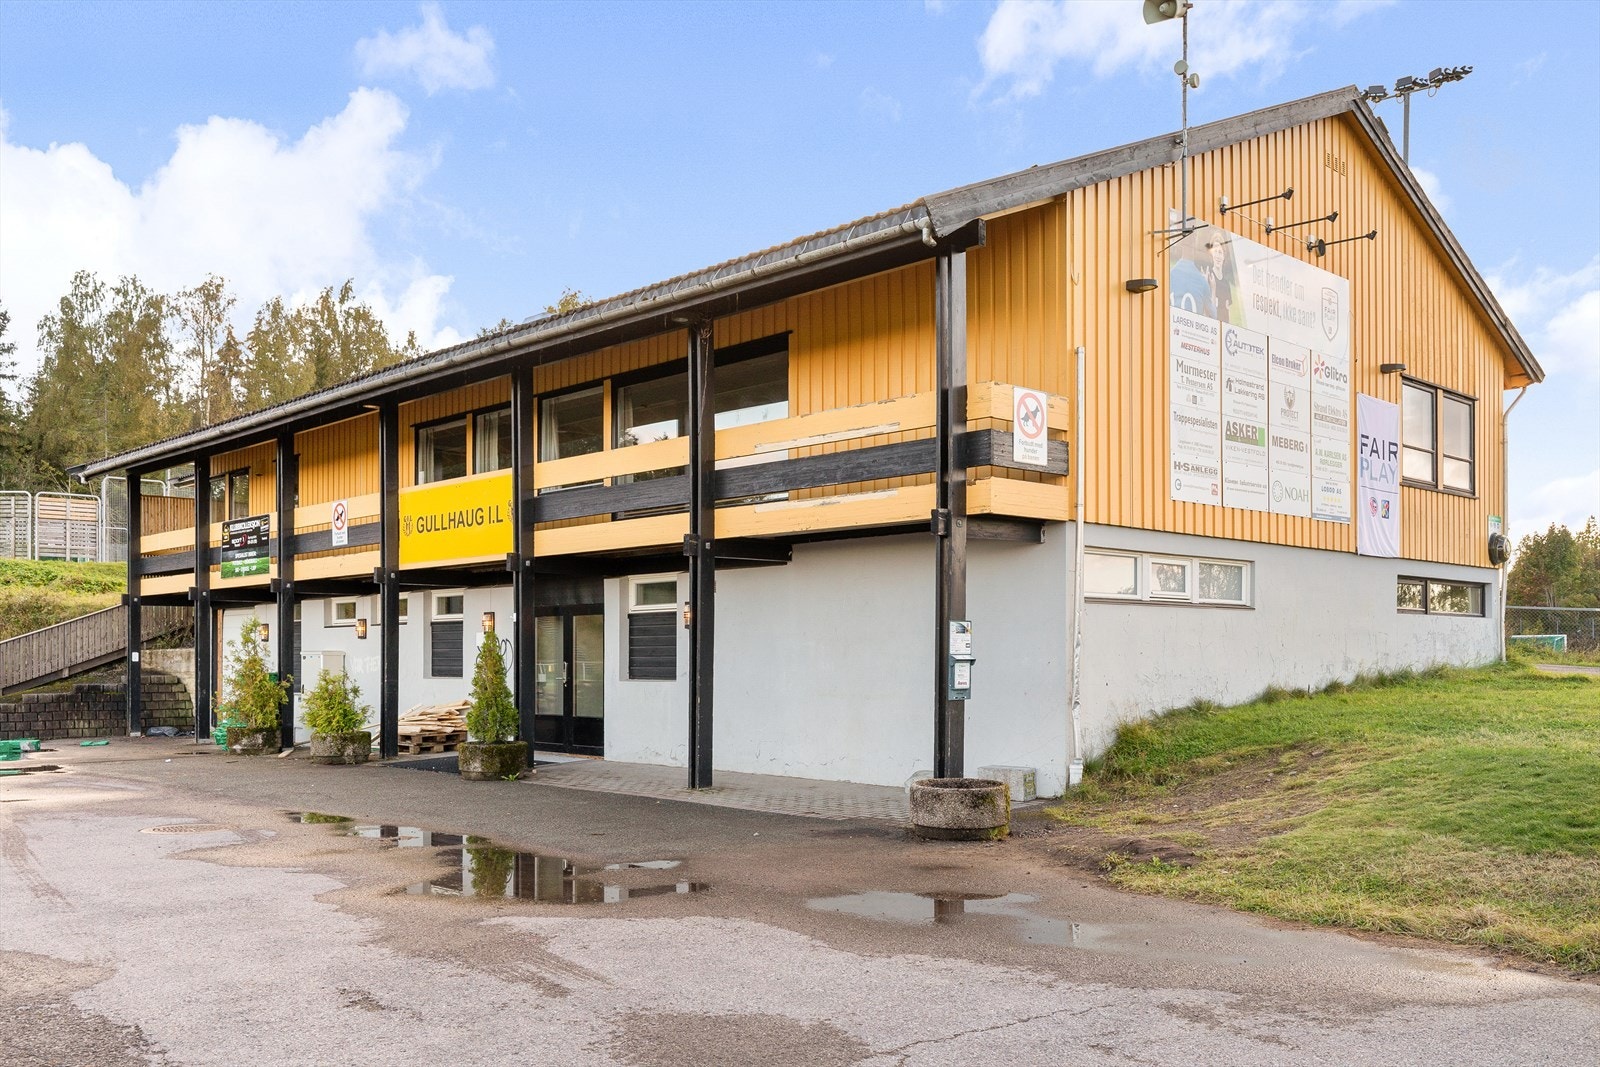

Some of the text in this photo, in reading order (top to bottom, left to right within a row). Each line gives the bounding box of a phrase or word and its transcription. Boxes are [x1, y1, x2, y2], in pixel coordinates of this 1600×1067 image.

[1253, 265, 1265, 287] Det
[1266, 271, 1293, 297] handler
[1295, 283, 1304, 301] om
[1253, 292, 1316, 328] respekt, ikke sant?
[1173, 315, 1194, 328] LARSEN
[1211, 327, 1217, 335] AS
[1181, 341, 1210, 356] MESTERHUS
[1176, 359, 1217, 381] Murmester
[1207, 382, 1213, 390] AS
[1234, 387, 1257, 400] Lakkering
[1235, 377, 1264, 391] Holmestrand
[1173, 411, 1218, 429] Trappespesialisten
[1225, 420, 1258, 440] ASKER
[1272, 435, 1304, 452] MEBERG
[1360, 434, 1398, 461] FAIR
[1191, 465, 1218, 475] ANLEGG
[1360, 457, 1397, 485] PLAY
[1284, 486, 1309, 502] NOAH
[416, 507, 484, 533] GULLHAUG
